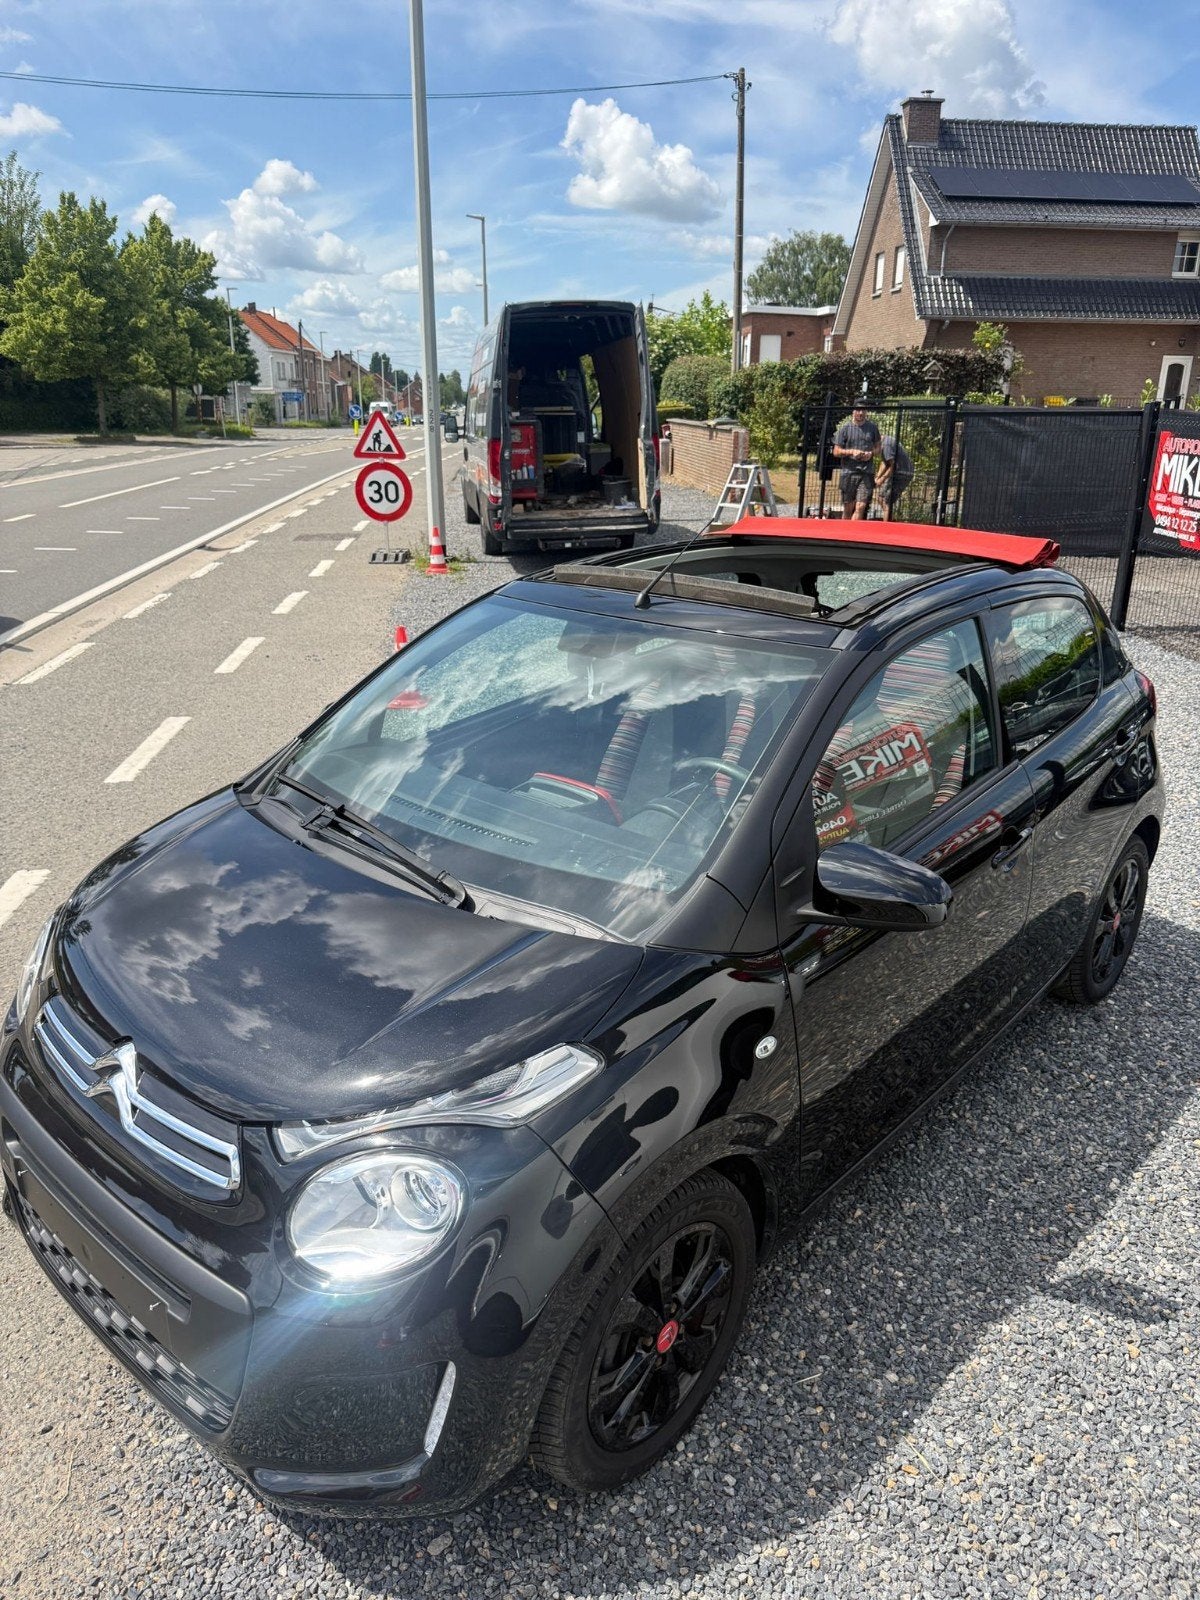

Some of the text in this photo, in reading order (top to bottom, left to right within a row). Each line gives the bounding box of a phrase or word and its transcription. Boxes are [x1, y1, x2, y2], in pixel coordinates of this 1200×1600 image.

[368, 480, 400, 504] 30
[1155, 514, 1198, 532] 0494 12 12 25
